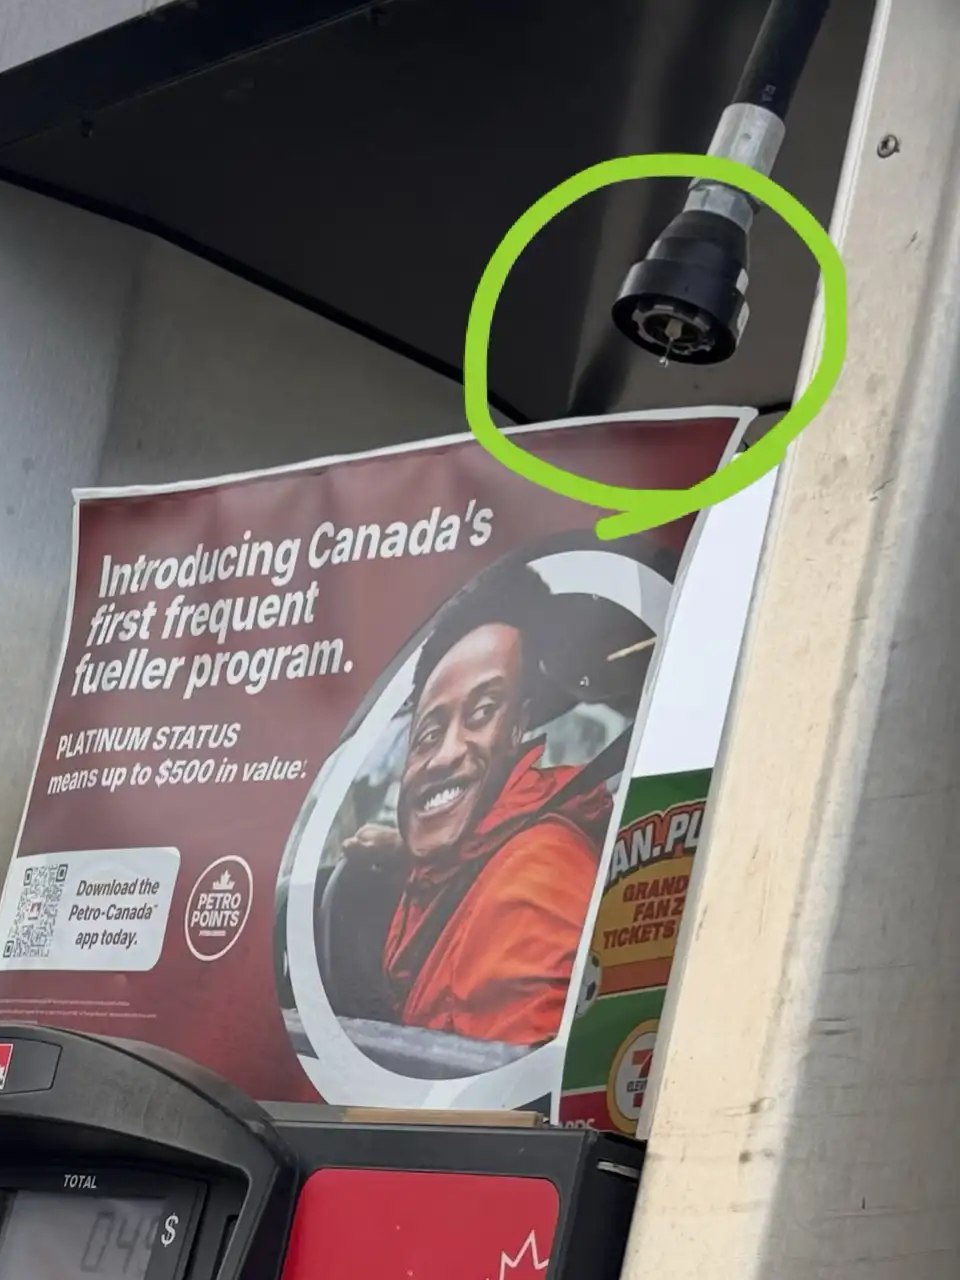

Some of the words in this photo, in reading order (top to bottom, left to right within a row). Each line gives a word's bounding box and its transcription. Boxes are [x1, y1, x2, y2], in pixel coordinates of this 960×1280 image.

[98, 529, 301, 598] Introducing
[307, 499, 494, 570] Canada's
[85, 603, 156, 647] first
[161, 580, 319, 644] frequent
[71, 647, 185, 697] fueller
[183, 637, 353, 699] program.
[56, 726, 152, 760] PLATINUM
[152, 722, 241, 751] STATUS
[47, 767, 97, 795] means
[101, 766, 126, 793] up
[131, 762, 151, 786] to
[155, 758, 215, 788] $500
[215, 757, 238, 783] in
[76, 878, 137, 897] Download
[139, 878, 160, 896] the
[197, 893, 241, 909] PETRO
[190, 911, 240, 928] POINTS
[603, 920, 676, 949] TICKETS
[74, 932, 99, 949] app
[100, 928, 138, 949] today.
[63, 1174, 97, 1189] TOTAL
[160, 1212, 179, 1248] $
